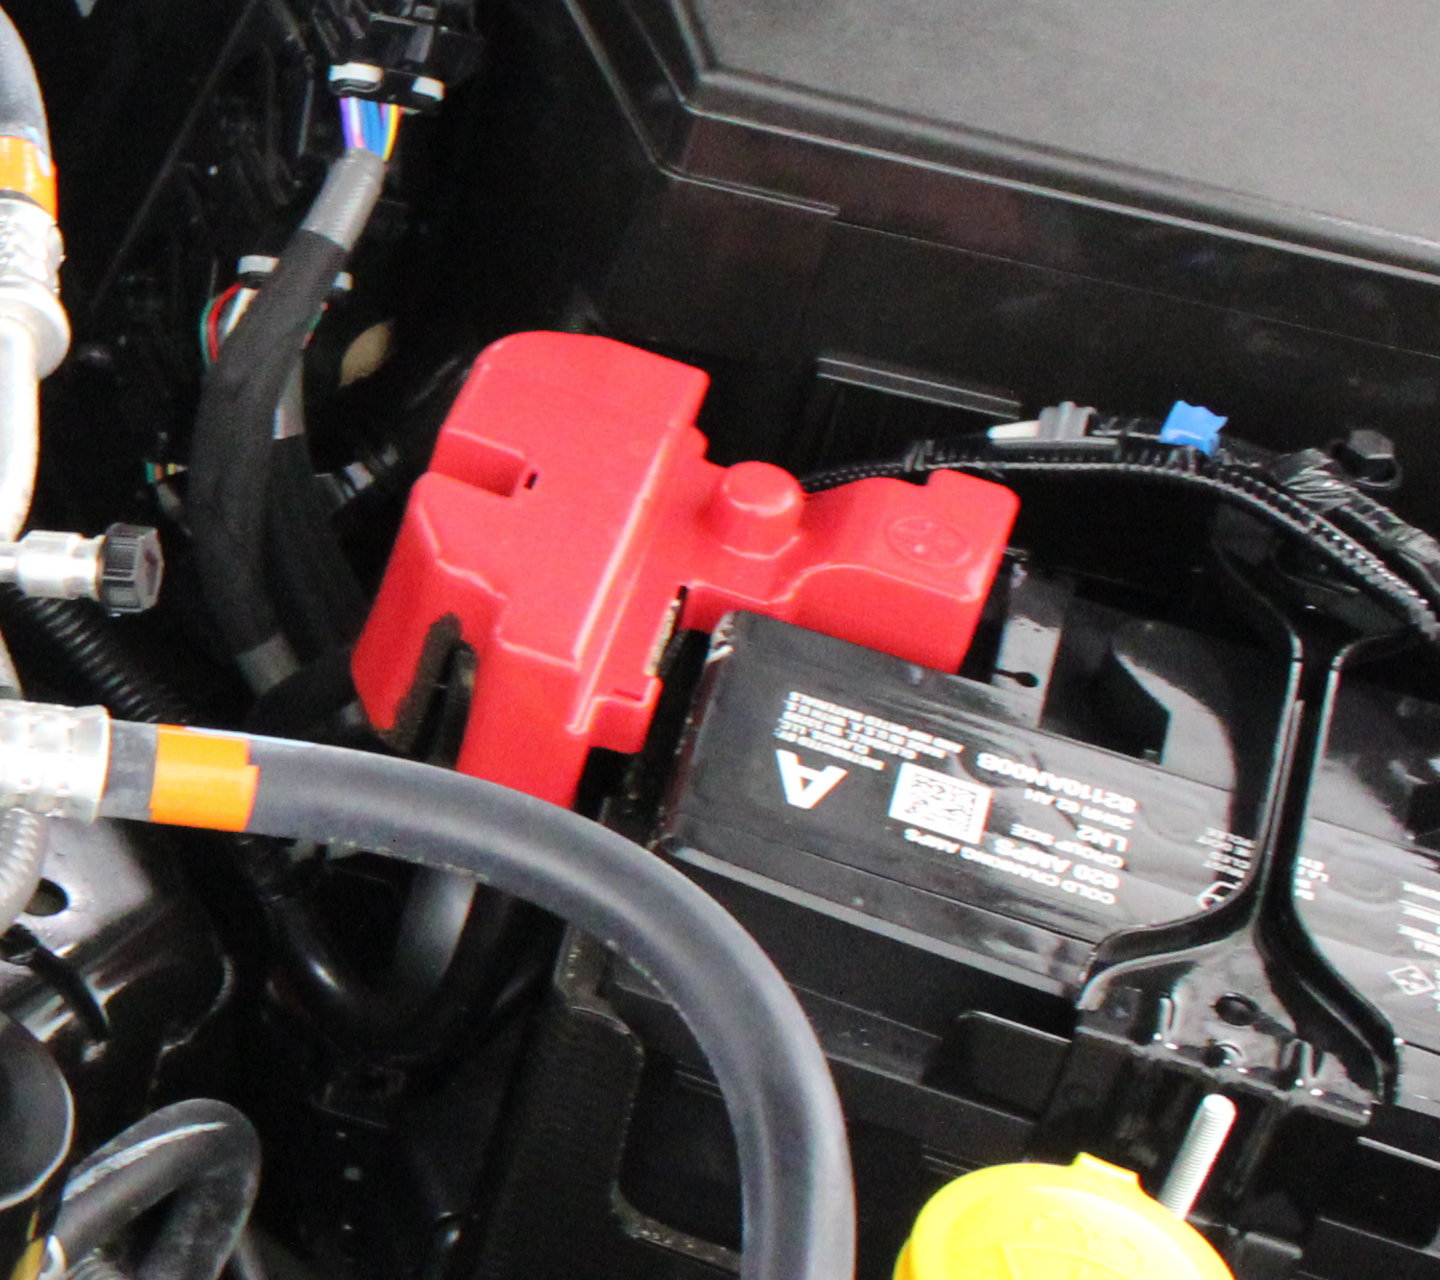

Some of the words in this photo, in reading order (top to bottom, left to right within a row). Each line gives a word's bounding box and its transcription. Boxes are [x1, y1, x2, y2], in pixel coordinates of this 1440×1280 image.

[1023, 787, 1055, 806] AH
[903, 827, 960, 855] AMPS
[1009, 822, 1055, 847] SIZE
[1075, 823, 1128, 852] LN2
[959, 845, 1061, 888] CRANKING
[992, 837, 1071, 874] AMPS
[1054, 838, 1124, 868] GROUP
[1072, 863, 1121, 890] 620
[1060, 878, 1116, 905] COLD
